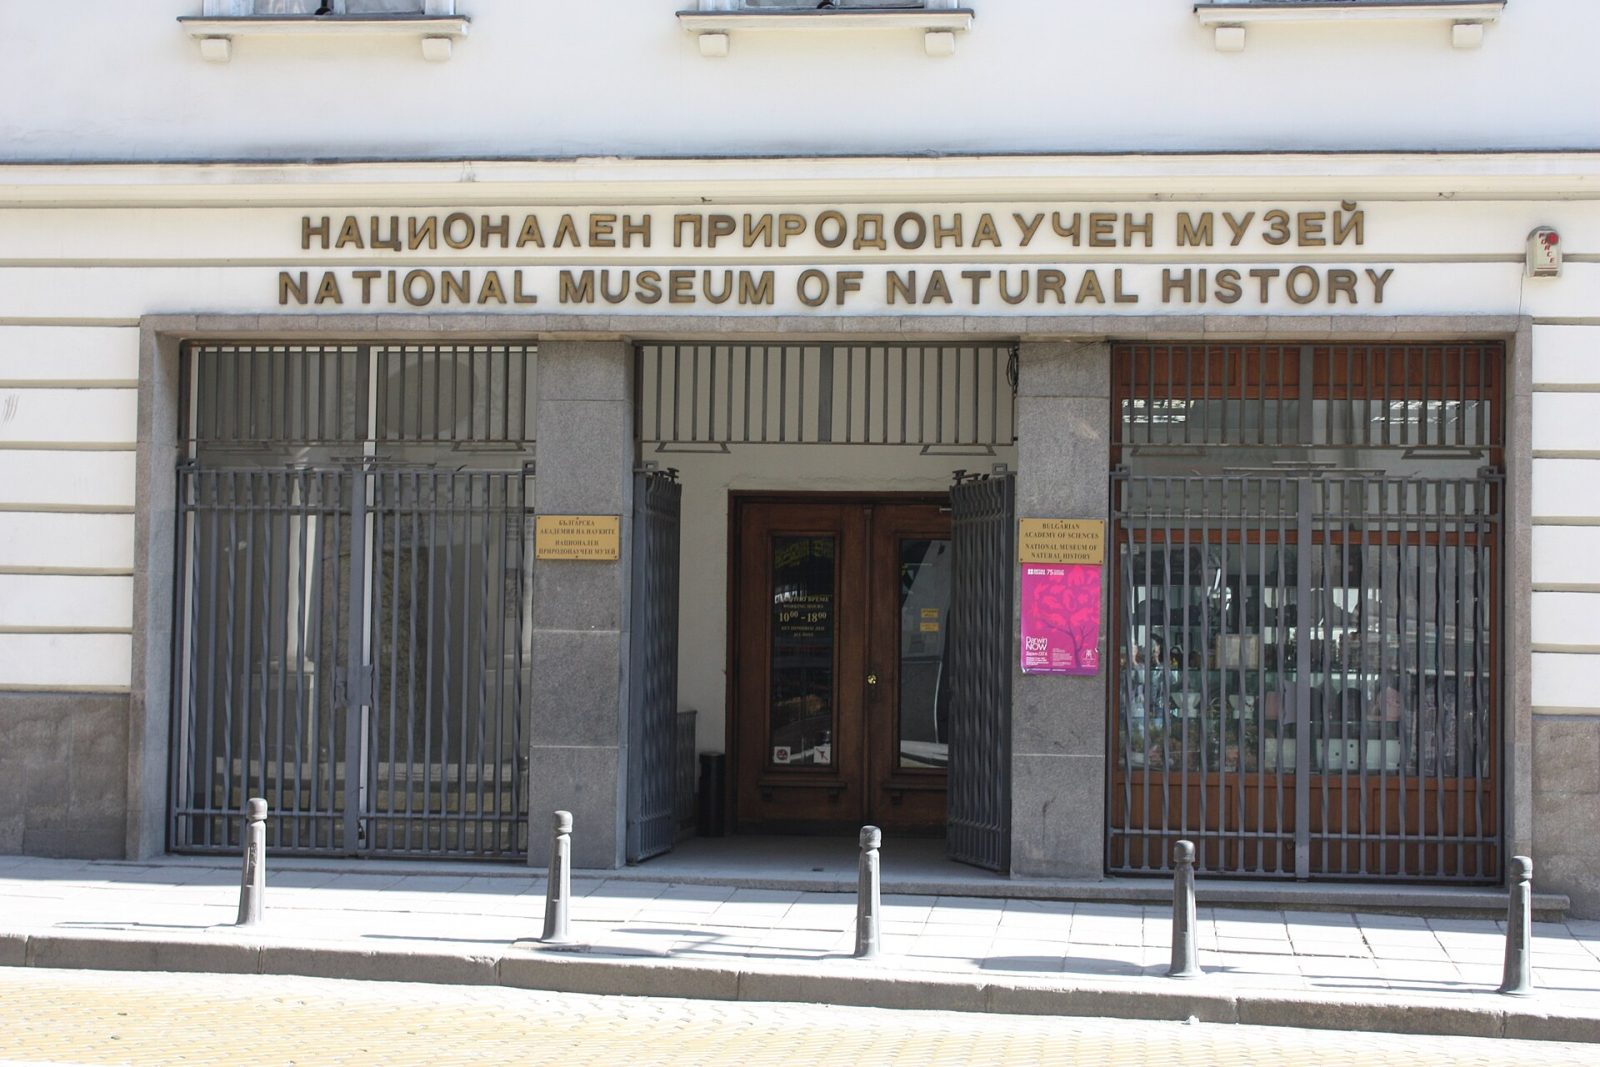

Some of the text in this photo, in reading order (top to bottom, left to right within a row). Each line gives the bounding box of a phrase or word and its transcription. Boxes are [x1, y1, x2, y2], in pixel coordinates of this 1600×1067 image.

[301, 200, 1365, 253] НАЦИОНАЛЕН ПРИРОДОНАУЧЕН МУЗЕЙ
[278, 265, 1395, 307] NATIONAL MUSEUM OF NATURAL HISTORY
[1025, 643, 1048, 651] NOW
